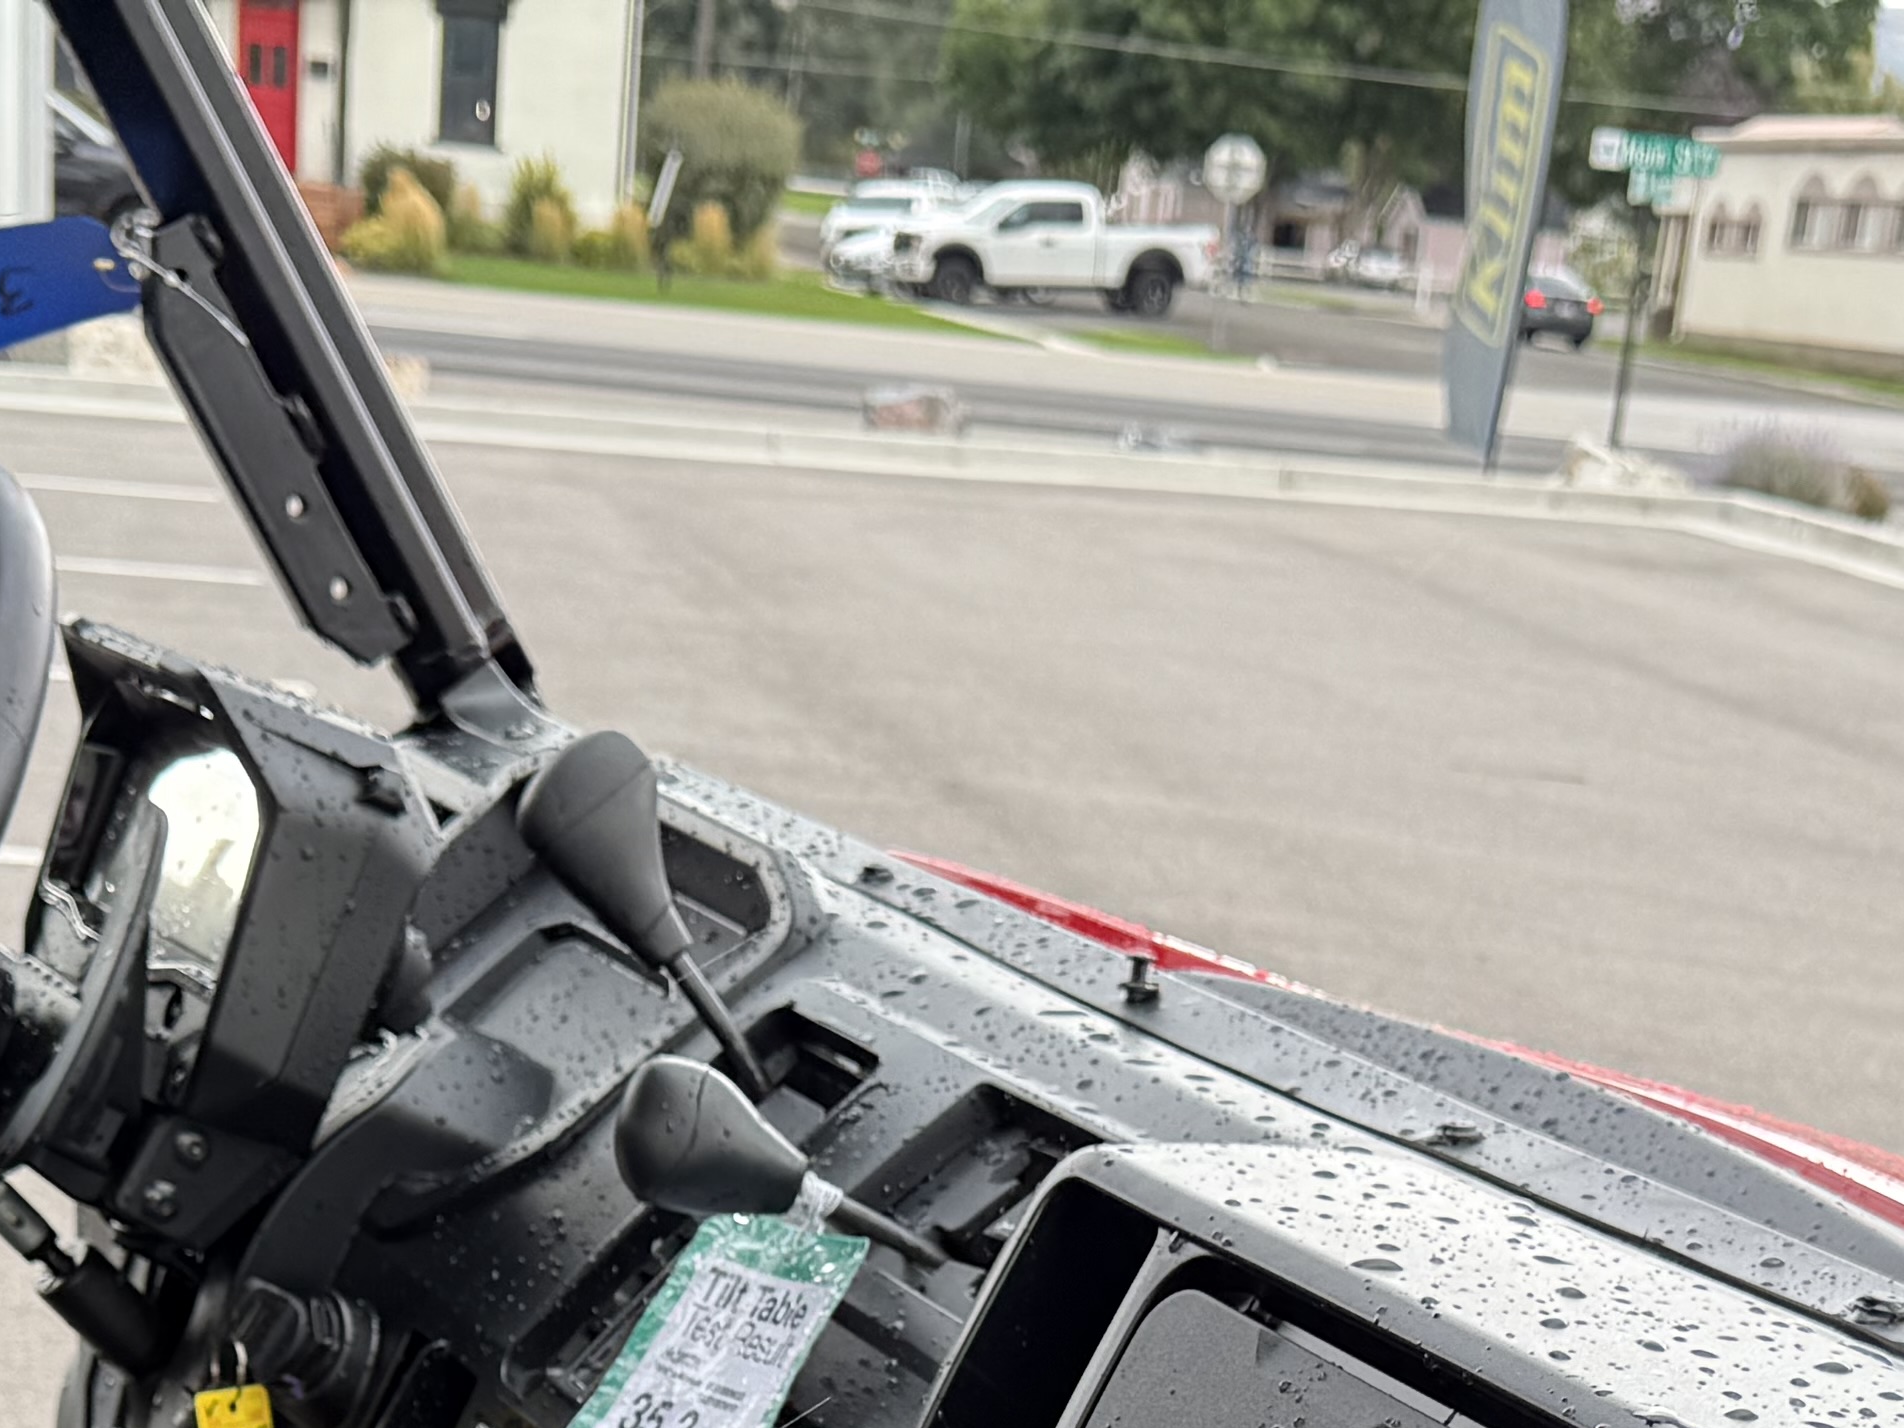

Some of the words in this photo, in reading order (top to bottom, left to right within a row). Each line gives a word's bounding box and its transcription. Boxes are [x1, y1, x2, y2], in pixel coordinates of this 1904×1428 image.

[698, 1266, 750, 1315] Tilt
[748, 1284, 809, 1330] Table
[681, 1302, 732, 1352] Test
[732, 1320, 796, 1369] Result
